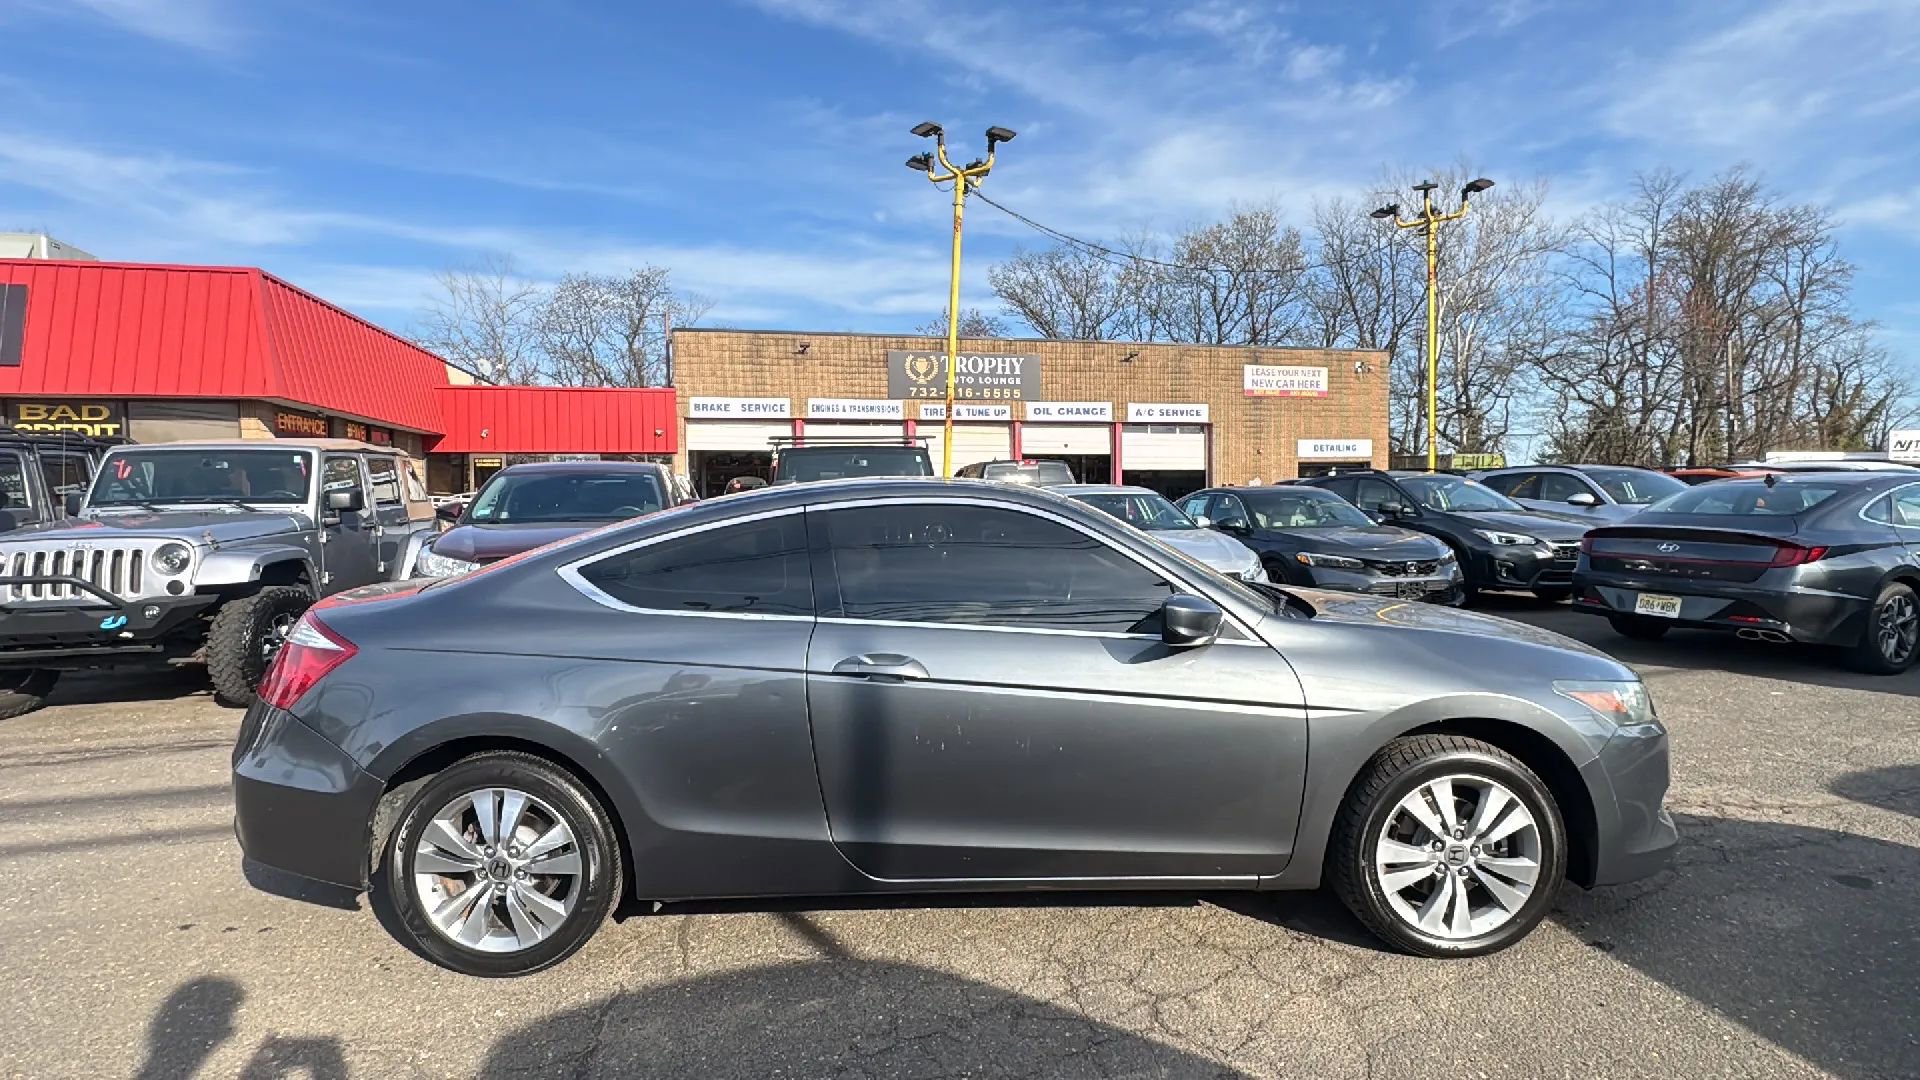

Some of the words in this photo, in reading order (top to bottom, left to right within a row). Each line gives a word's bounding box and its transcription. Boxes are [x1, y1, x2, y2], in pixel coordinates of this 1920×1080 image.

[1251, 368, 1275, 377] LEASE
[1277, 369, 1299, 377] YOUR
[1301, 370, 1322, 378] NEXT
[945, 376, 975, 385] UTO
[979, 377, 1021, 385] LOUNGE
[1251, 379, 1274, 388] NEW
[1275, 380, 1295, 389] CAR
[1297, 380, 1321, 389] HERE
[909, 387, 1022, 399] 732-16-5555
[18, 403, 111, 421] BAD
[693, 403, 731, 412] BRAKE
[741, 403, 786, 413] SERVICE
[811, 404, 840, 413] ENGINES
[842, 405, 847, 413] &
[849, 405, 900, 414] TRANSMISSIONS
[965, 409, 991, 417] TUNE
[994, 409, 1007, 417] UP
[1033, 407, 1053, 416] OIL
[1057, 407, 1107, 416] CHANGE
[1135, 408, 1155, 417] A/C
[1159, 408, 1202, 417] SERVICE
[276, 412, 327, 435] ENTRANCE
[1313, 444, 1357, 453] DETAILING
